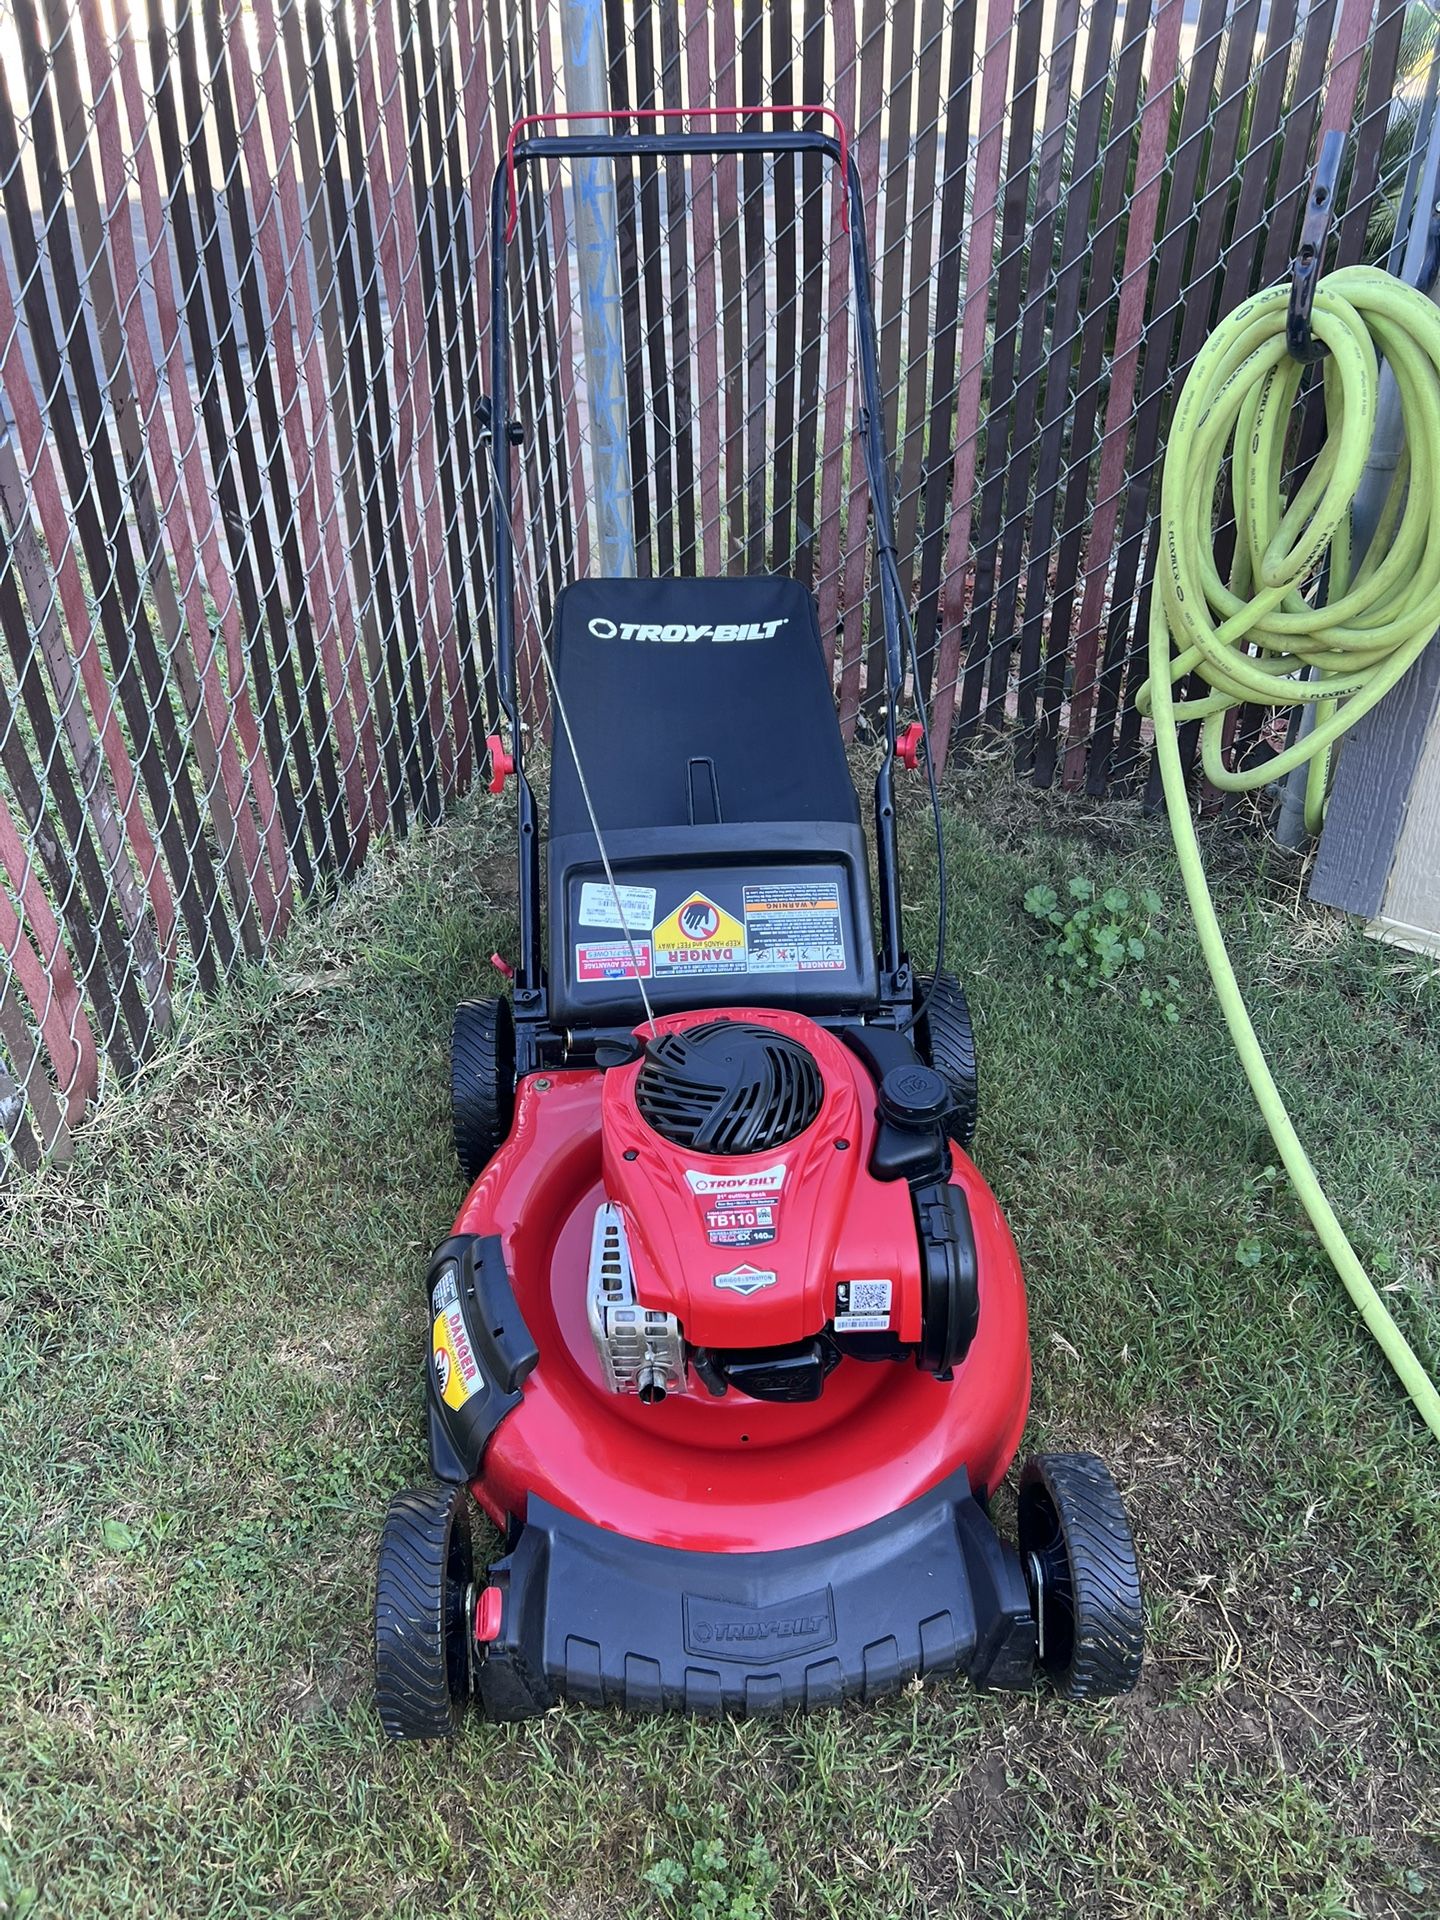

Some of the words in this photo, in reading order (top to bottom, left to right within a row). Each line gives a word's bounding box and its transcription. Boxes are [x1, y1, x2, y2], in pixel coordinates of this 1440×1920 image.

[1168, 530, 1180, 582] FLEXZILLA
[619, 618, 789, 642] TROY-BILT
[668, 948, 733, 962] DANGER
[583, 961, 620, 969] ADVANTAGE
[620, 960, 646, 968] SEVICE
[800, 961, 835, 969] DANGER
[709, 1176, 777, 1188] TROY-BILT
[707, 1213, 755, 1227] TB110
[449, 1313, 477, 1380] DANGER
[715, 1615, 829, 1642] TROY-BILT
